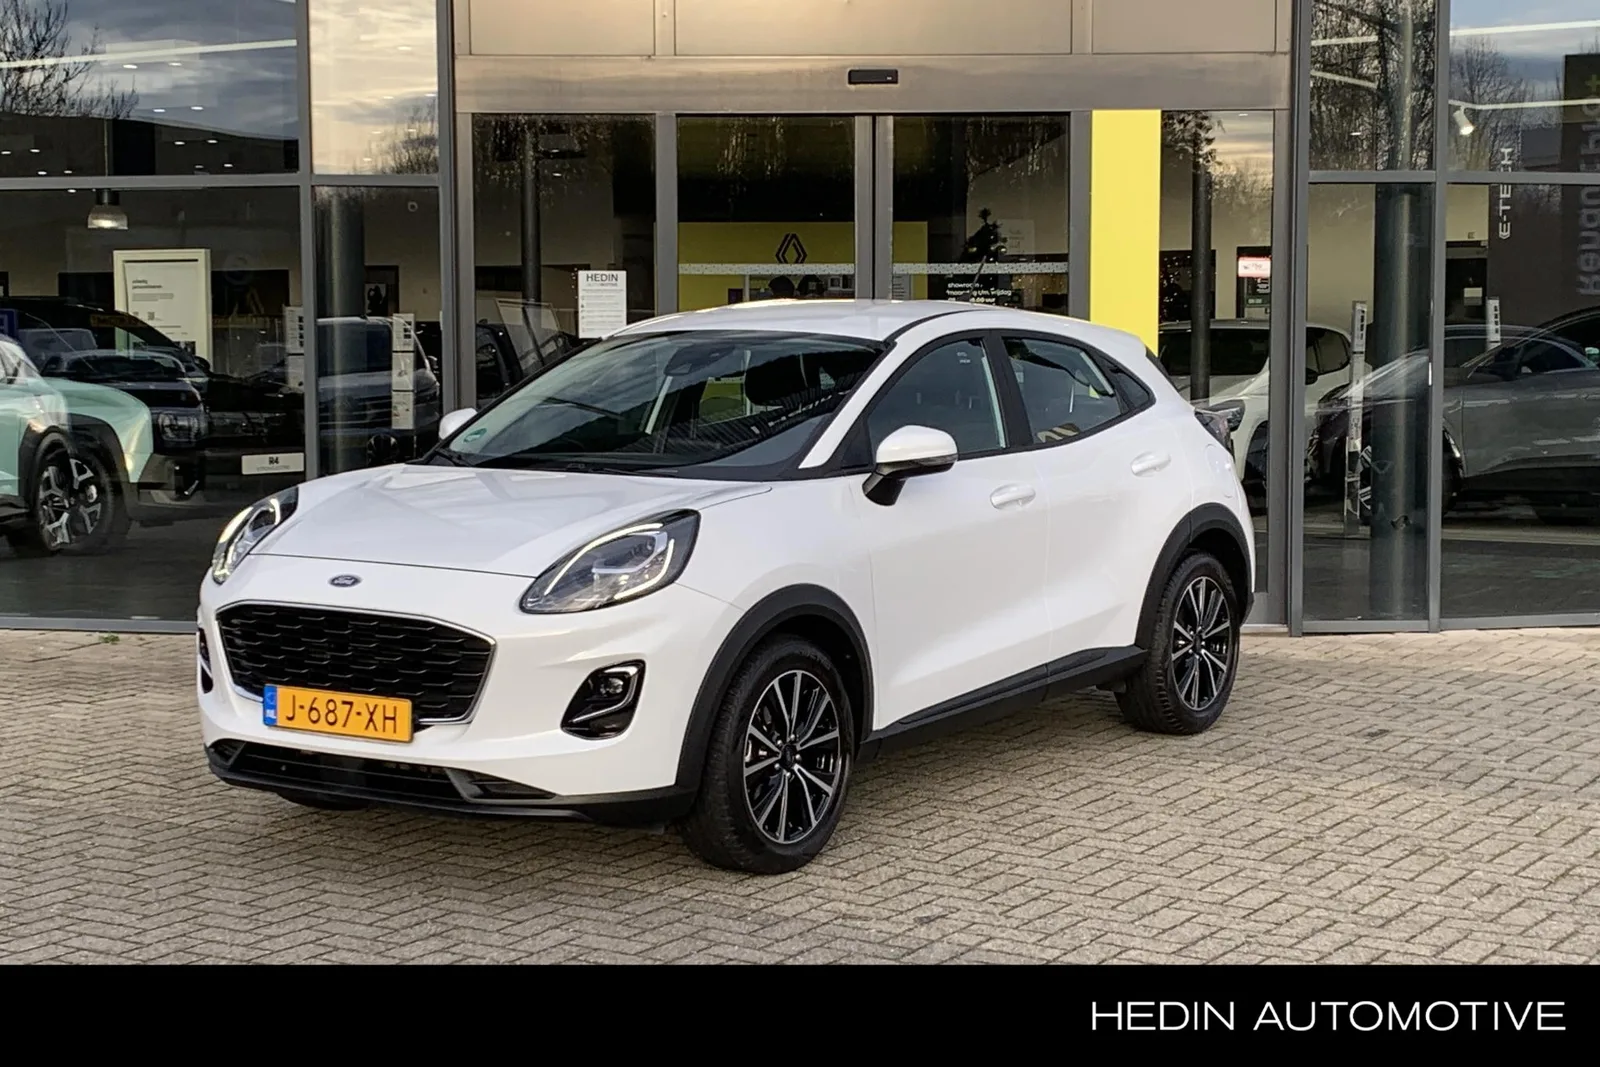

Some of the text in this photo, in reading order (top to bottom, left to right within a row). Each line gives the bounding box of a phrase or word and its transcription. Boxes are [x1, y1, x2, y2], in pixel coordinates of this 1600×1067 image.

[586, 273, 619, 282] HEDIN
[268, 456, 279, 465] R4
[334, 576, 355, 585] Ford
[286, 694, 398, 734] J-687-XH
